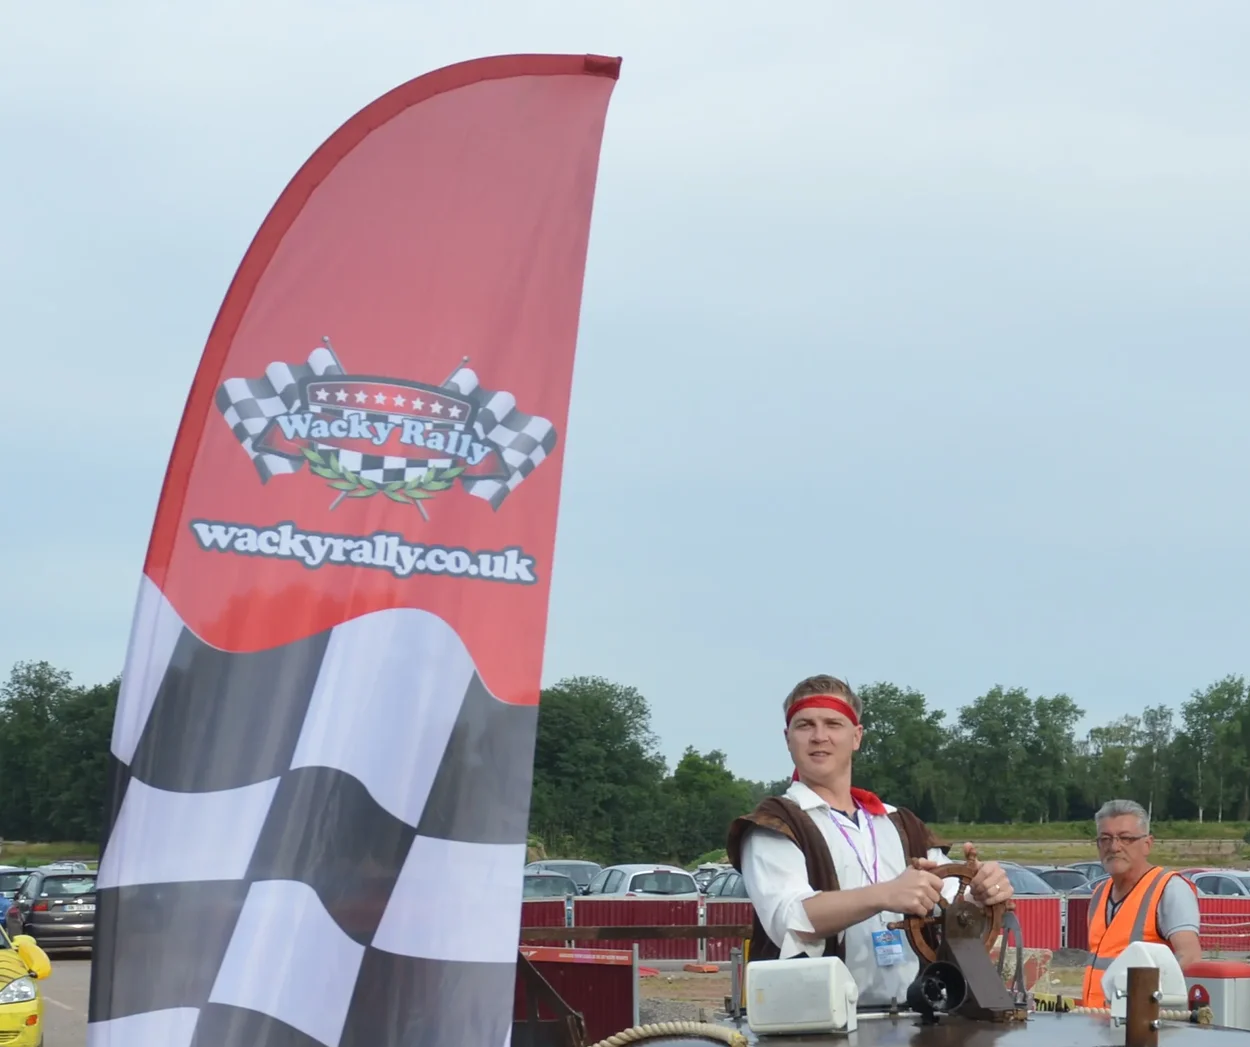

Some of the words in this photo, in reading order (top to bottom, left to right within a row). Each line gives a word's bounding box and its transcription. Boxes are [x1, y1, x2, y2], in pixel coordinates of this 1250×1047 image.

[276, 412, 396, 446] Wacky
[399, 417, 494, 466] Rally
[191, 522, 536, 583] wackyrally.co.uk
